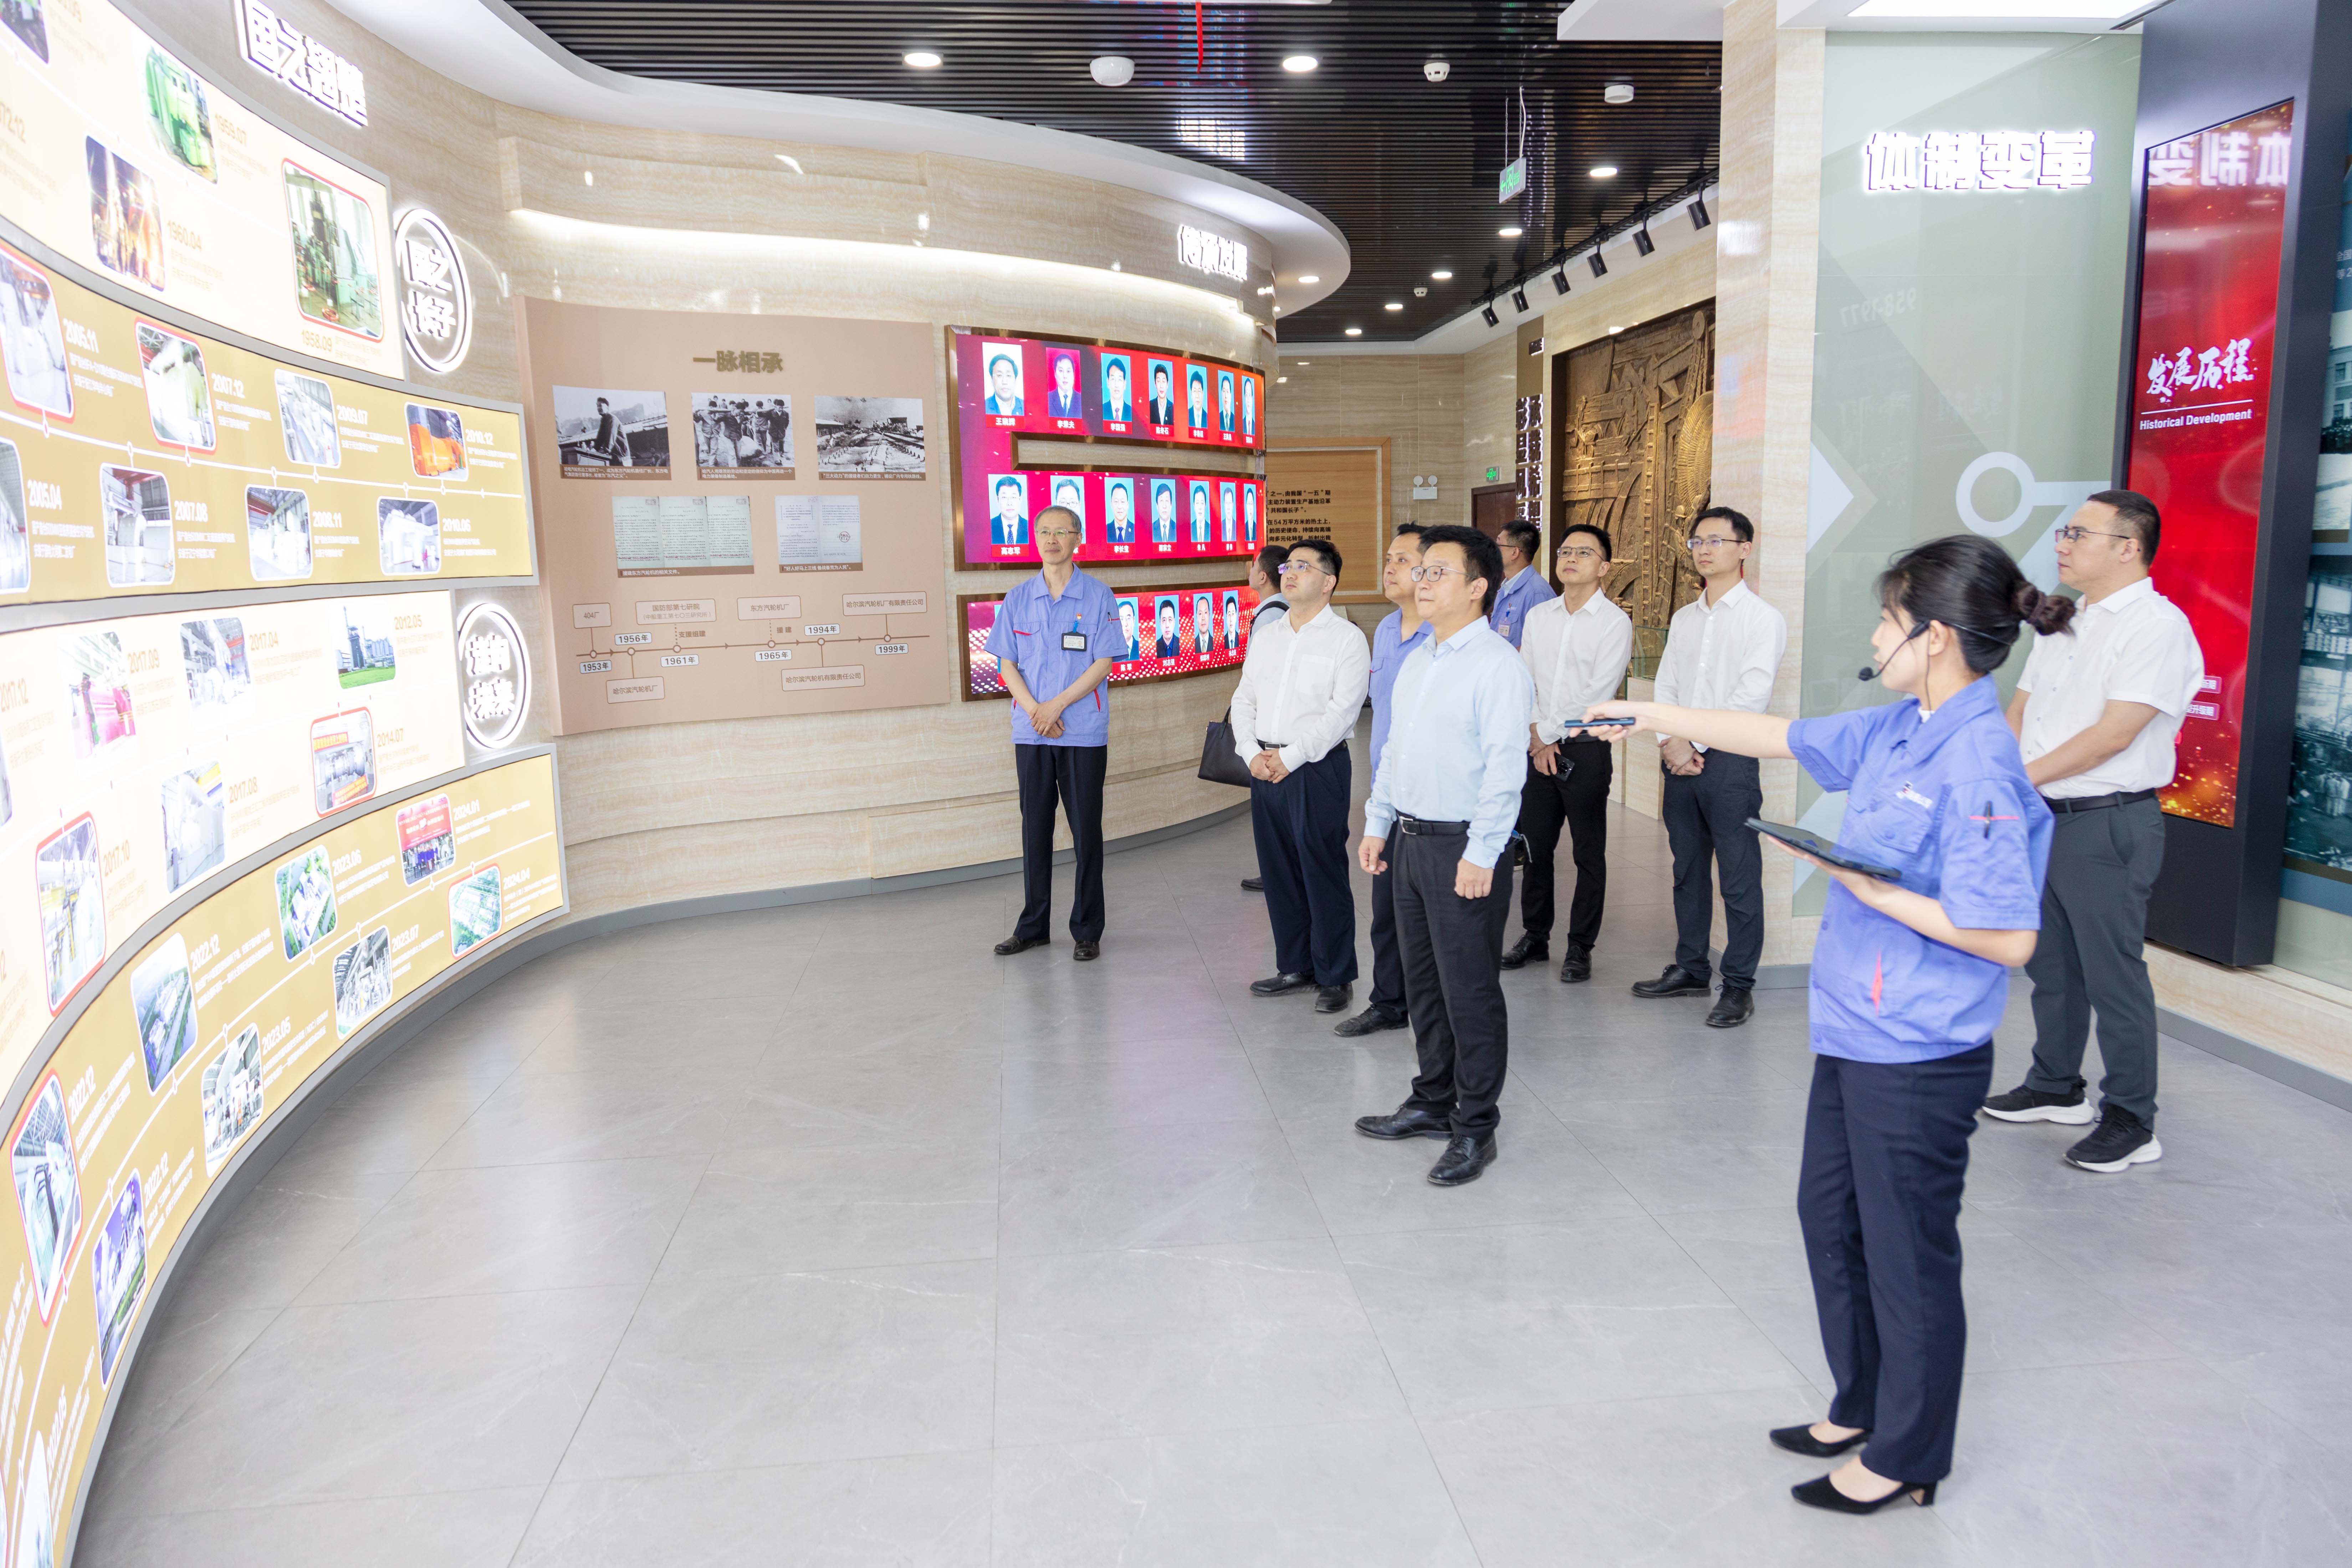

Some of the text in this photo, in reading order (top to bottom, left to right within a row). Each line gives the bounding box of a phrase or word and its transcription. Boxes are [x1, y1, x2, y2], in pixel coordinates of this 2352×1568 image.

[215, 114, 247, 147] 1959.07
[1867, 131, 2096, 190] 体制变革
[167, 220, 202, 251] 1960.04
[63, 317, 99, 353] 2005.11
[302, 329, 332, 352] 1958.09
[693, 350, 783, 373] 一脉相承
[2146, 338, 2254, 397] 发展历程
[211, 371, 245, 399] 2007.12
[2139, 409, 2252, 430] Historical Development
[465, 429, 495, 446] 2010.12
[27, 478, 62, 510] 2005.04
[174, 500, 209, 523] 2007.08
[1001, 547, 1021, 555] 高志军
[750, 604, 789, 612] 东方汽轮机厂
[846, 599, 924, 608] 哈尔滨汽轮机厂有限责任公司
[394, 613, 423, 630] 2012.05
[808, 625, 837, 634] 1994年
[250, 628, 280, 651] 2017.04
[619, 634, 648, 644] 1956年
[879, 645, 905, 654] 1999年
[127, 647, 160, 674] 2017.09
[583, 662, 609, 672] 1953年
[665, 656, 695, 666] 1961年
[758, 651, 788, 660] 1965年
[1162, 658, 1175, 667] 刘志强
[786, 672, 861, 683] 哈尔滨汽轮机有限责任公司
[613, 685, 658, 695] 哈尔滨汽轮机厂
[377, 728, 404, 748] 2014.07
[229, 775, 258, 804] 2017.08
[453, 799, 480, 821] 2024.01
[103, 839, 131, 877] 2017.10
[332, 849, 362, 877] 2023.06
[503, 867, 531, 890] 2024.04
[392, 924, 419, 952] 2023.07
[190, 933, 221, 973] 2022.12
[262, 1015, 291, 1057] 2023.05
[68, 1065, 96, 1125] 2022.12
[144, 1149, 169, 1209] 2022.12
